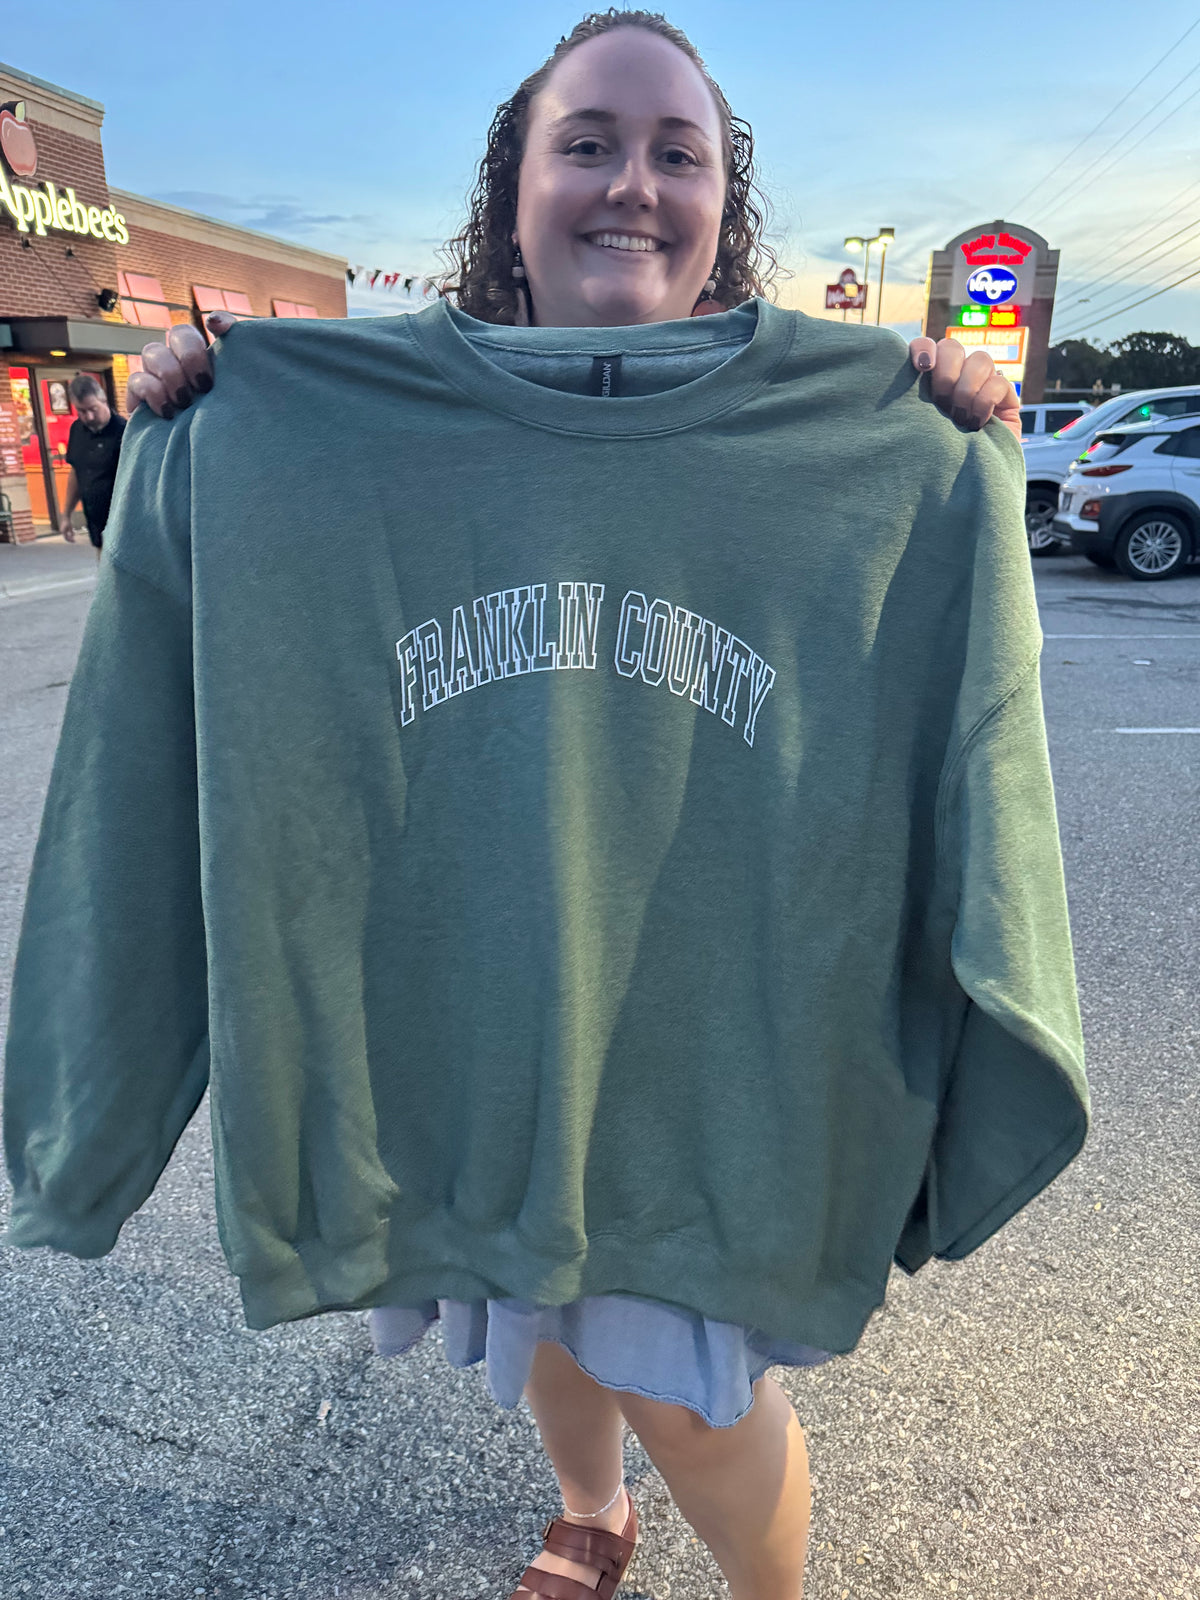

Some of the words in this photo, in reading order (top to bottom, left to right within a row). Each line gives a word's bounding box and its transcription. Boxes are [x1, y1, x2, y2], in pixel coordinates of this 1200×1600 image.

[969, 271, 1015, 300] Kroger
[602, 362, 611, 398] GILDAN
[396, 582, 605, 727] FRANKLIN
[614, 590, 776, 748] COUNTY
